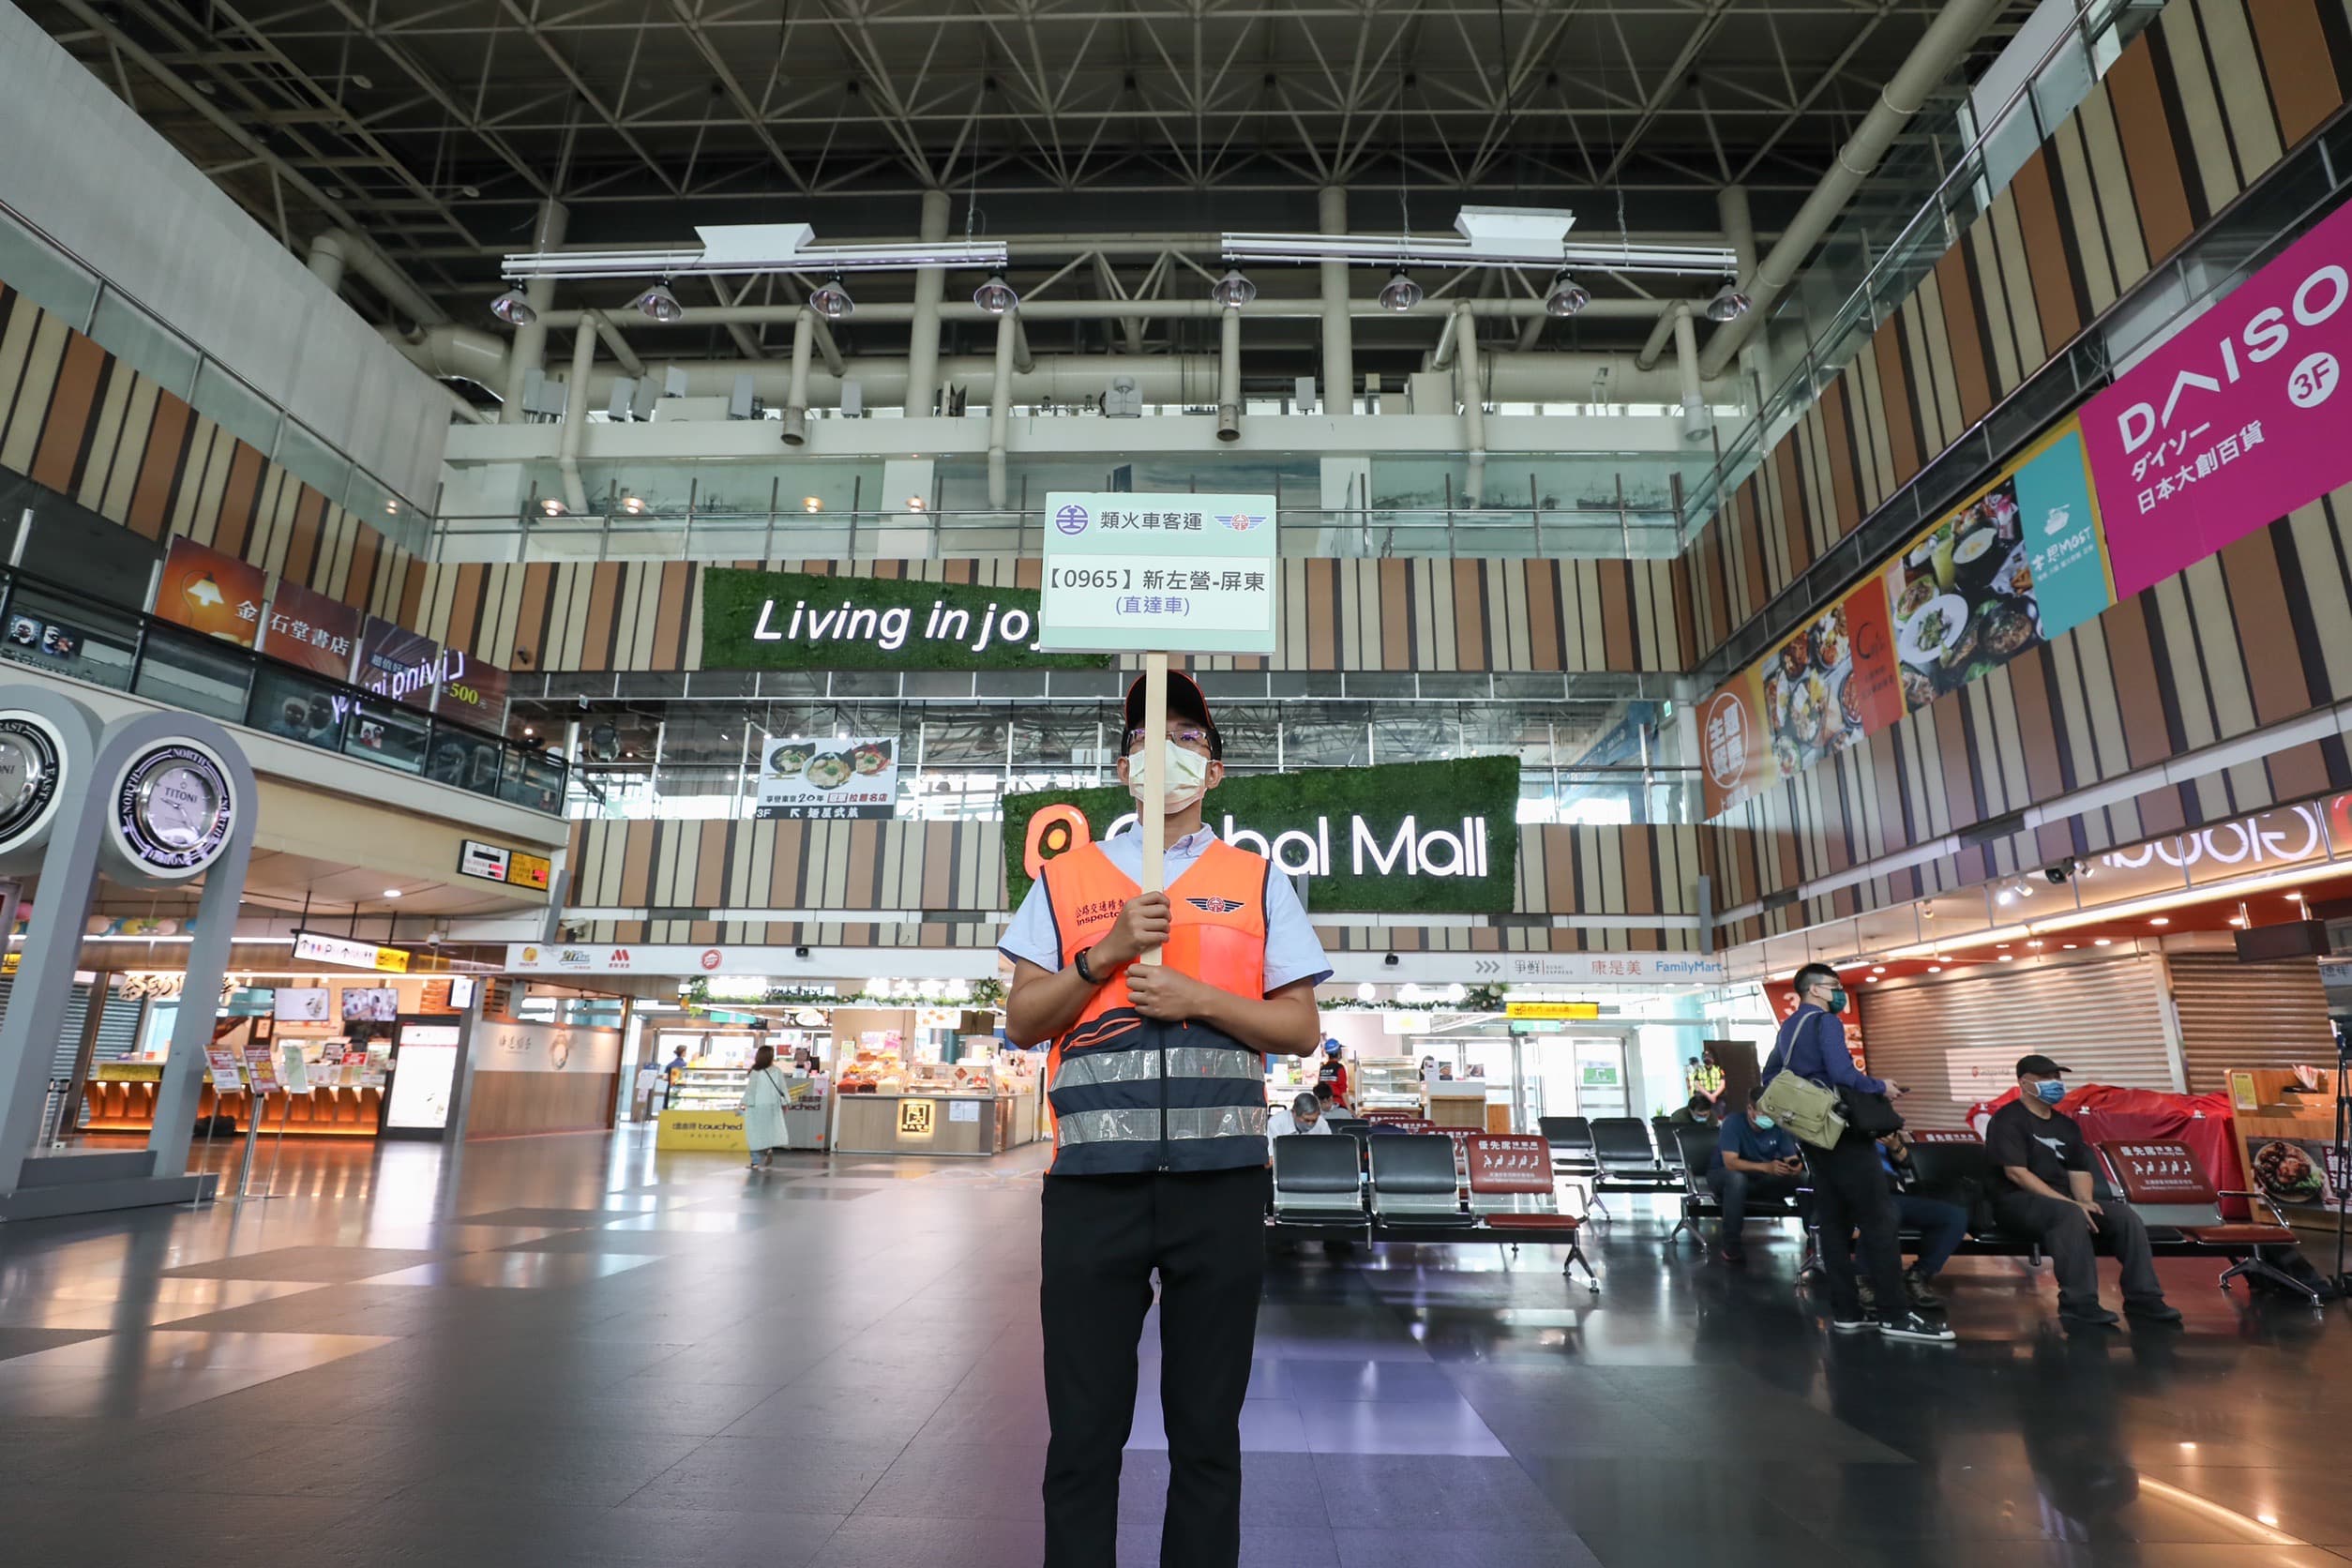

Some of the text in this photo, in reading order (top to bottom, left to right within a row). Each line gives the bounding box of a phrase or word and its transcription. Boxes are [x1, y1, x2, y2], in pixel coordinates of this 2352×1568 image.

[2117, 264, 2349, 455] DAISO
[2293, 357, 2330, 400] 3F
[2131, 421, 2211, 482] ダイソー
[2136, 419, 2266, 515] 日本大創百貨
[1099, 511, 1203, 532] 類火車客運
[1115, 596, 1191, 617] (直達車)
[234, 599, 351, 656] 金石堂書店
[753, 599, 912, 650] Living
[925, 600, 970, 641] in
[449, 682, 479, 704] 500
[172, 747, 207, 767] NORTH
[122, 770, 143, 814] NORTH
[164, 787, 199, 804] TITONI
[756, 808, 772, 818] 3F
[1351, 814, 1488, 877] Mall
[1076, 912, 1121, 927] Inspecto
[1591, 959, 1642, 976] 康是美
[1655, 960, 1723, 975] FamilyMart
[698, 1122, 743, 1130] touched
